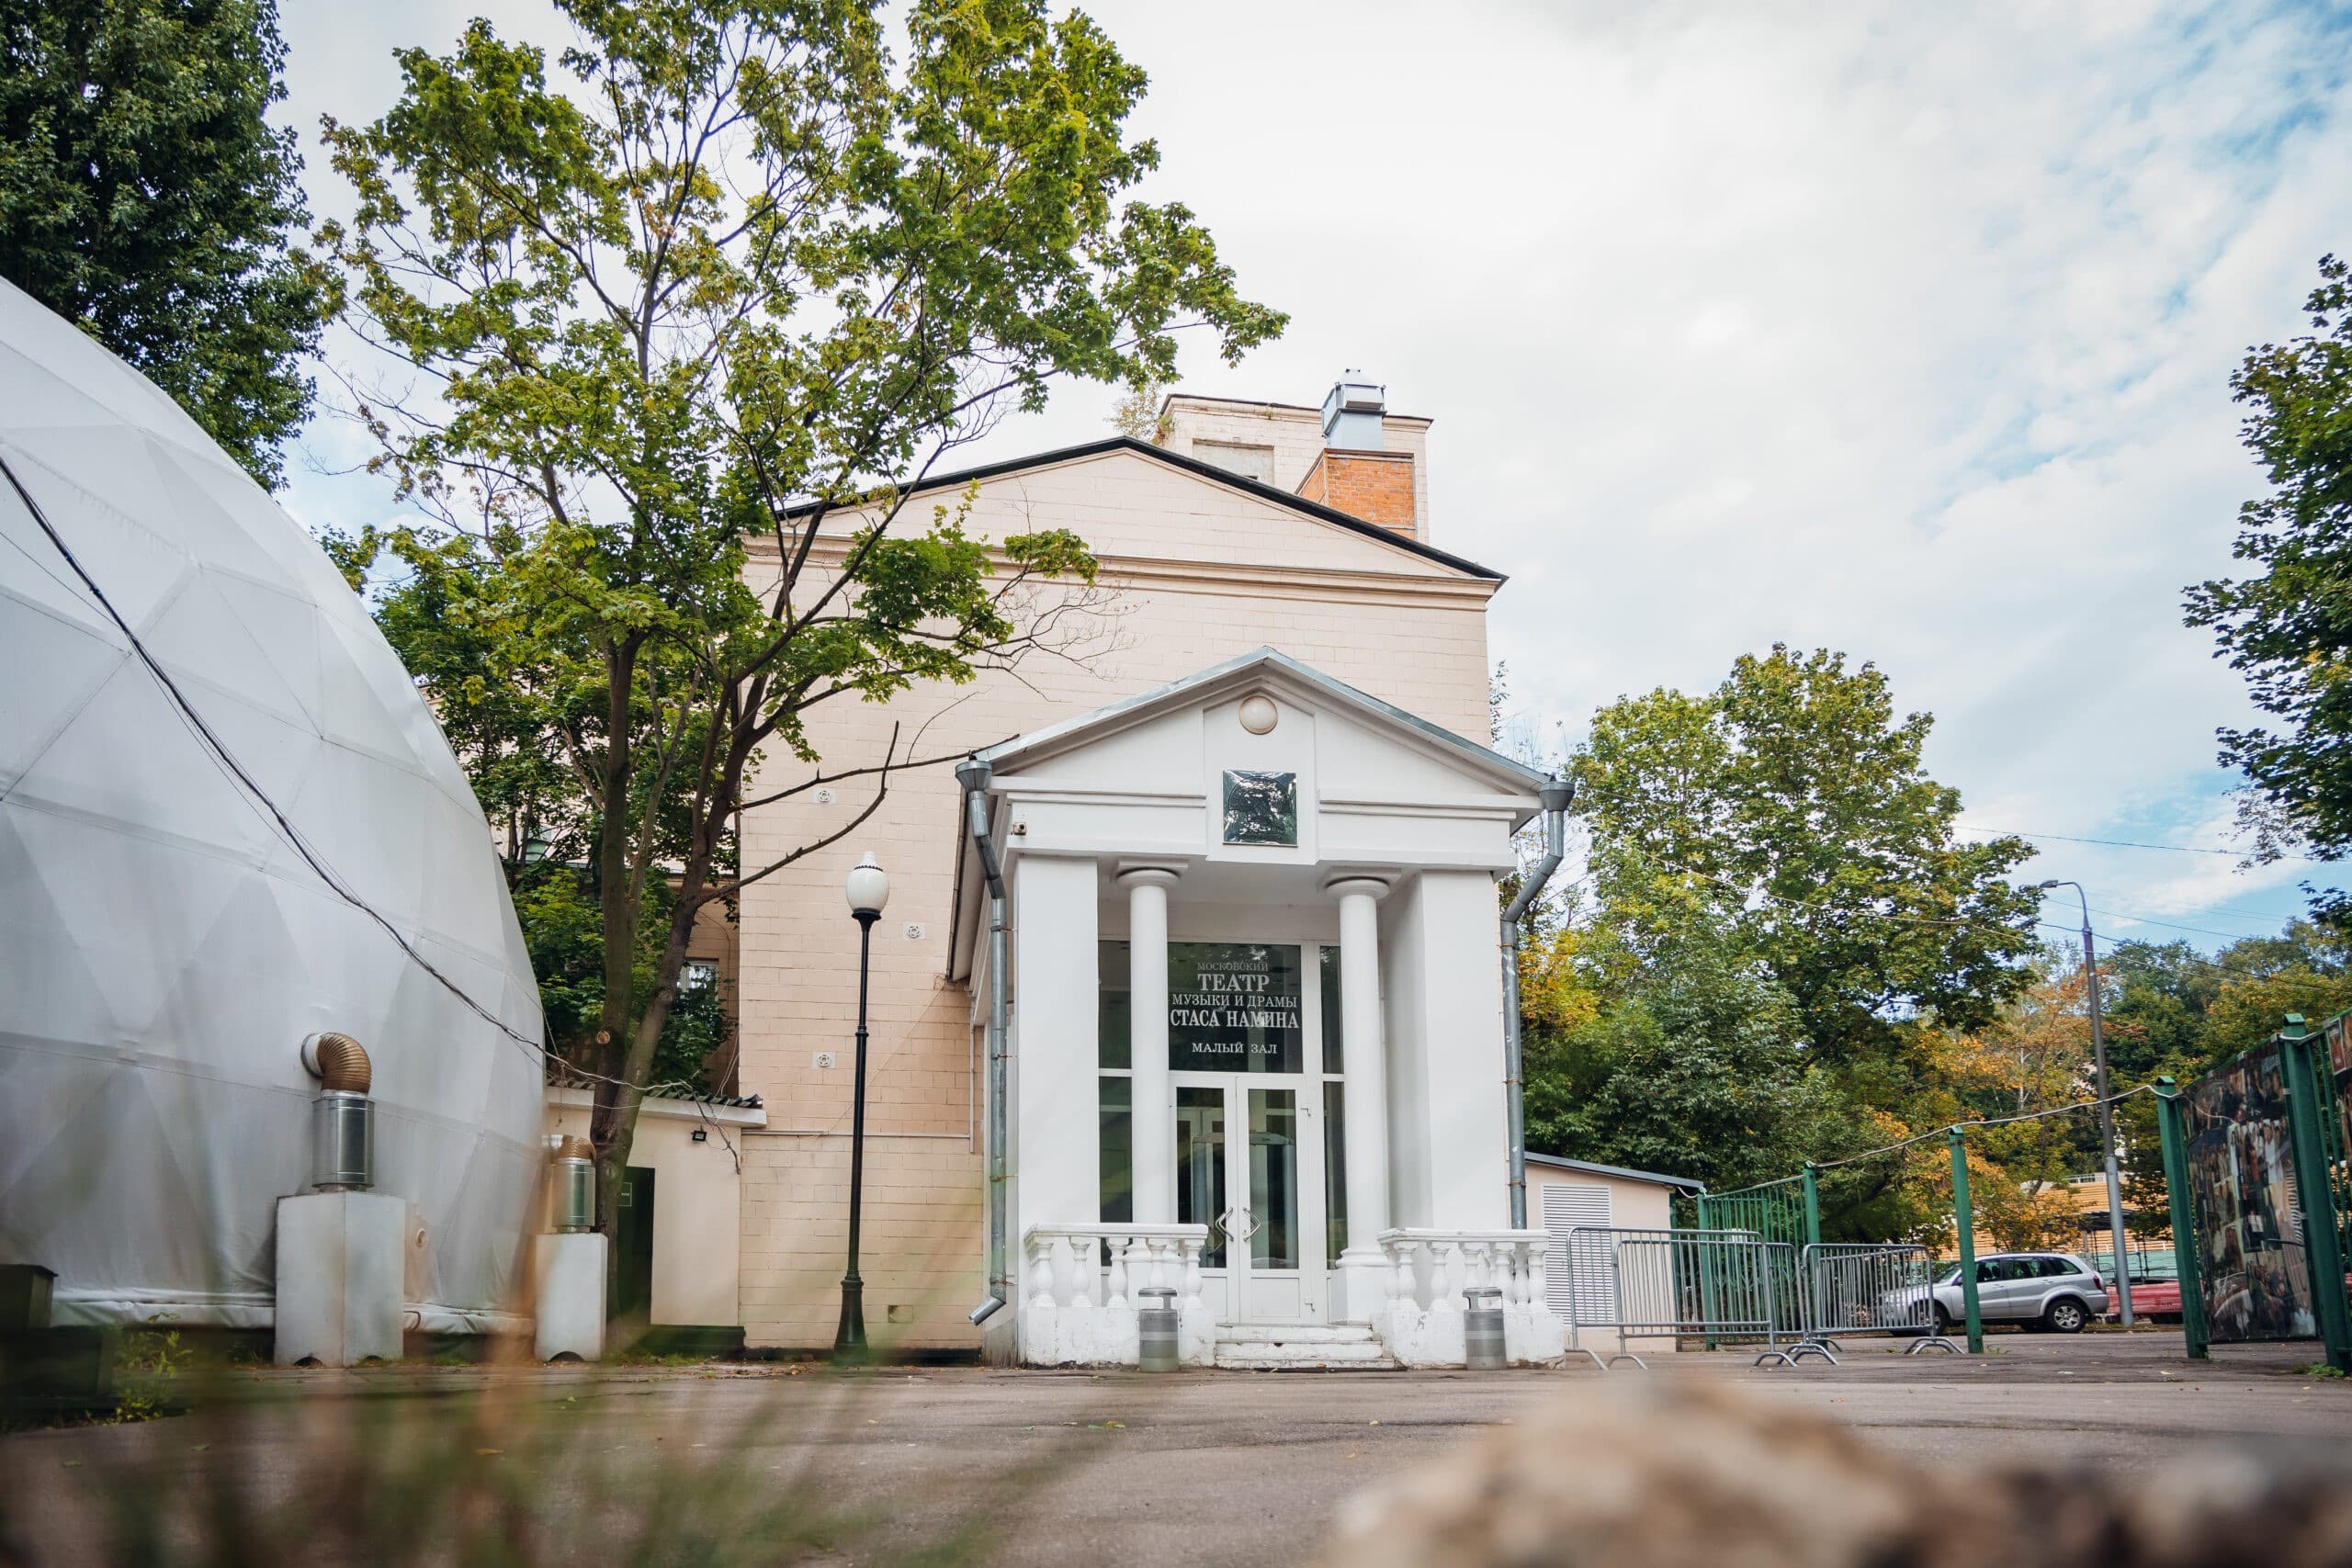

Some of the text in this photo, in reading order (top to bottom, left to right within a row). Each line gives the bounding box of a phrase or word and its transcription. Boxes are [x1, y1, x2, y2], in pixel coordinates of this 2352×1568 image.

[1197, 961, 1269, 971] МОСКОВСКИЙ
[1197, 974, 1270, 991] ТЕАТР
[1172, 994, 1297, 1009] МУЗЫКИ И ДРАМЫ
[1170, 1010, 1300, 1028] СТАСА НАМИНА
[1192, 1042, 1277, 1054] МАЛЫЙ ЗАЛ
